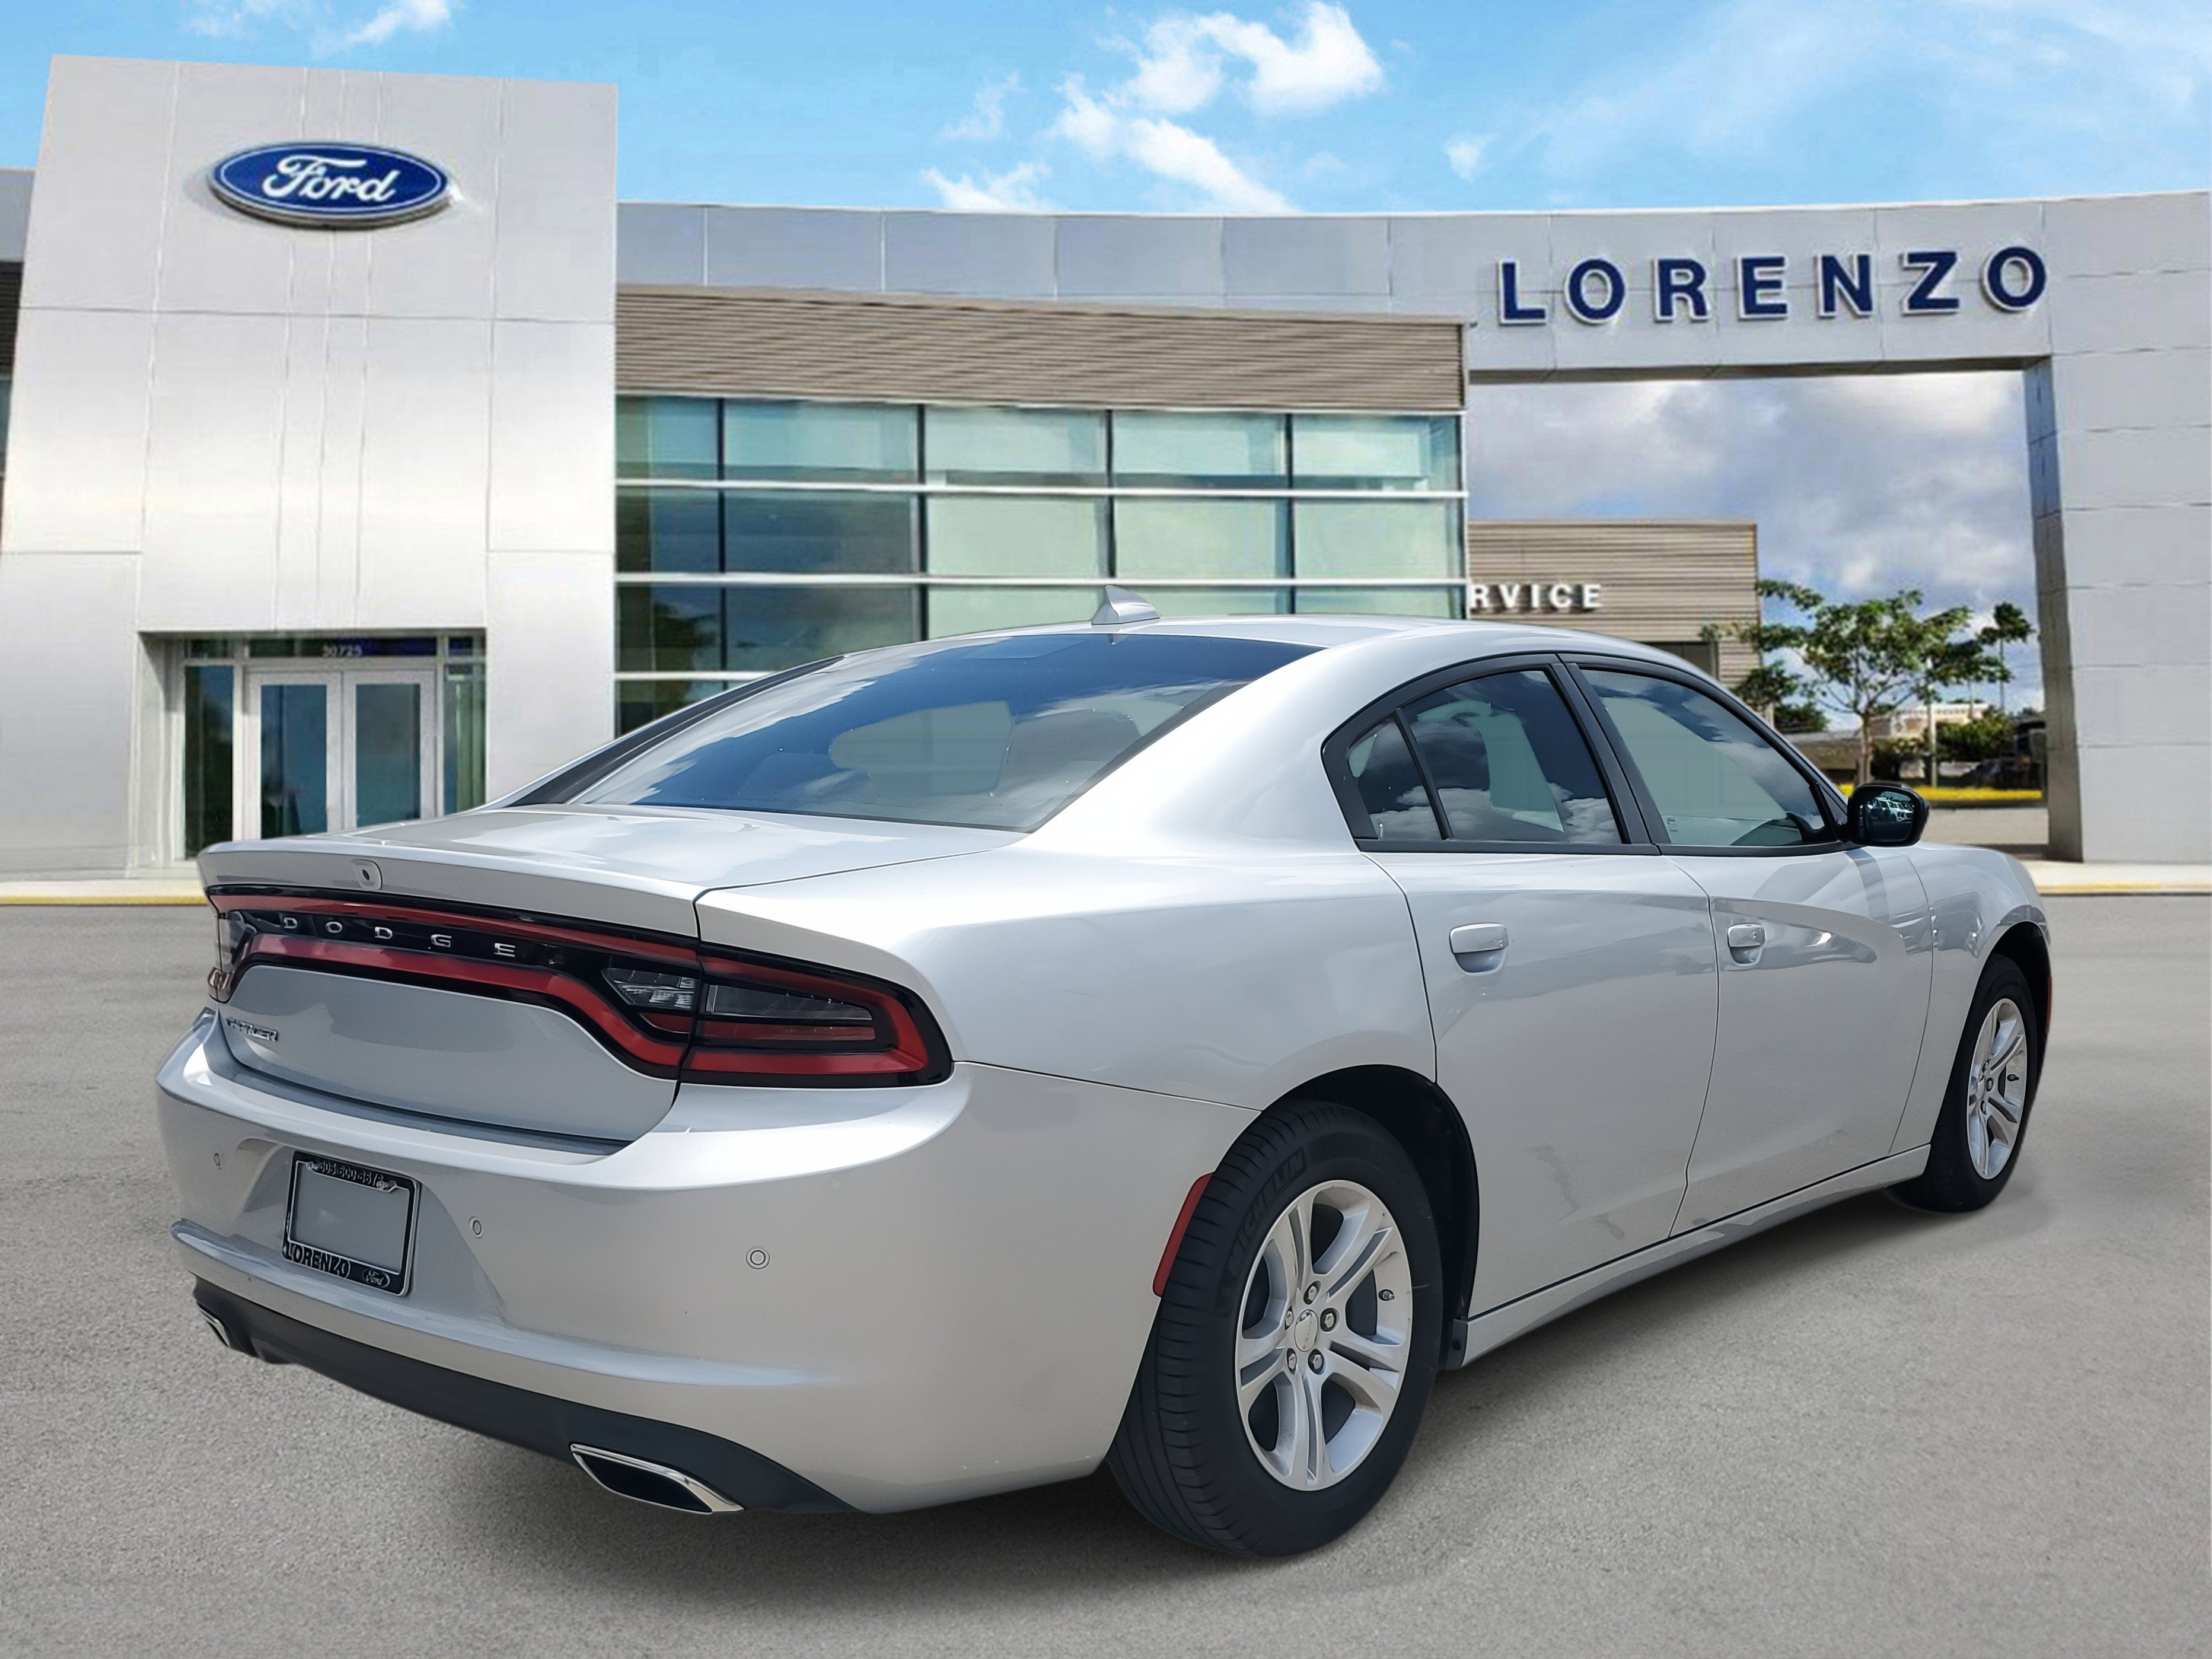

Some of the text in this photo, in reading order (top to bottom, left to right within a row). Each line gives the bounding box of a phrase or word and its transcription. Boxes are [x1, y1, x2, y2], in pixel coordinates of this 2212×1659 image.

[262, 155, 401, 201] Ford
[1497, 246, 2048, 327] LORENZO
[283, 916, 516, 957] DODGE
[286, 1242, 350, 1279] LORENZO
